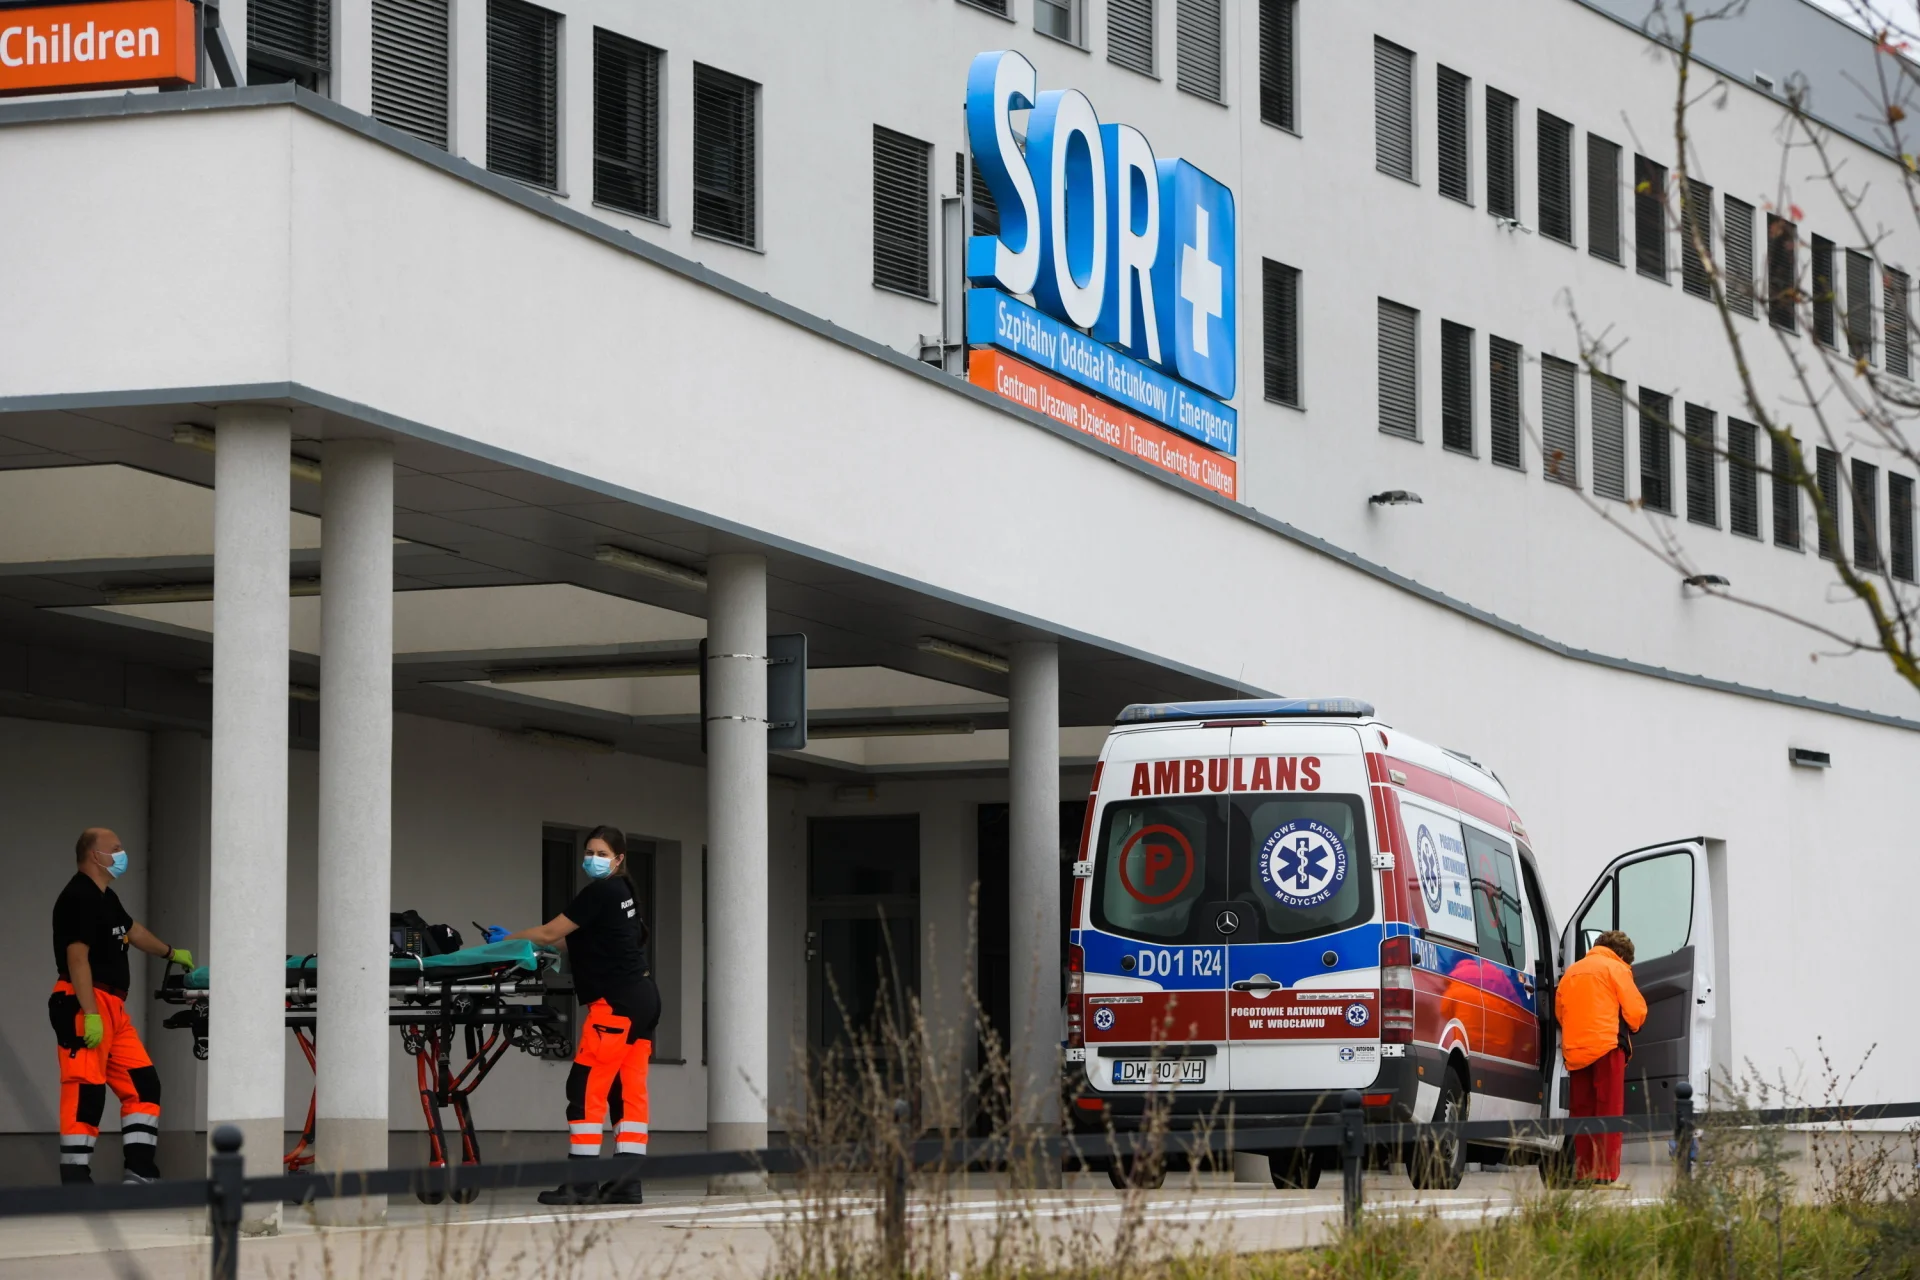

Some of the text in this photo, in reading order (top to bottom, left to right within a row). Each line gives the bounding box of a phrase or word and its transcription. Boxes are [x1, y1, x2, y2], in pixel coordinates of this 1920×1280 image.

[0, 21, 159, 67] Children
[993, 50, 1162, 365] SOR
[998, 300, 1233, 452] Szpitalny Oddział Ratunkowy / Emergency
[997, 365, 1038, 408] Centrum
[1040, 384, 1079, 427] Urazowe
[1080, 403, 1120, 444] Dziecięce
[1129, 426, 1160, 462] Trauma
[1161, 441, 1188, 475] Centre
[1189, 453, 1200, 480] for
[1202, 459, 1233, 494] Children
[1130, 756, 1321, 797] AMBULANS
[1144, 844, 1173, 886] P
[1259, 822, 1296, 883] PAŃSTWOWE
[1309, 822, 1346, 881] RATOWNICTWO
[1275, 889, 1331, 906] MEDYCZNE
[1138, 949, 1222, 977] D01 R24
[1231, 1007, 1285, 1017] POGOTOWIE
[1286, 1006, 1343, 1016] RATUNKOWE
[1249, 1018, 1325, 1029] WE WROCŁAWIU
[1123, 1063, 1202, 1078] DW 407VH
